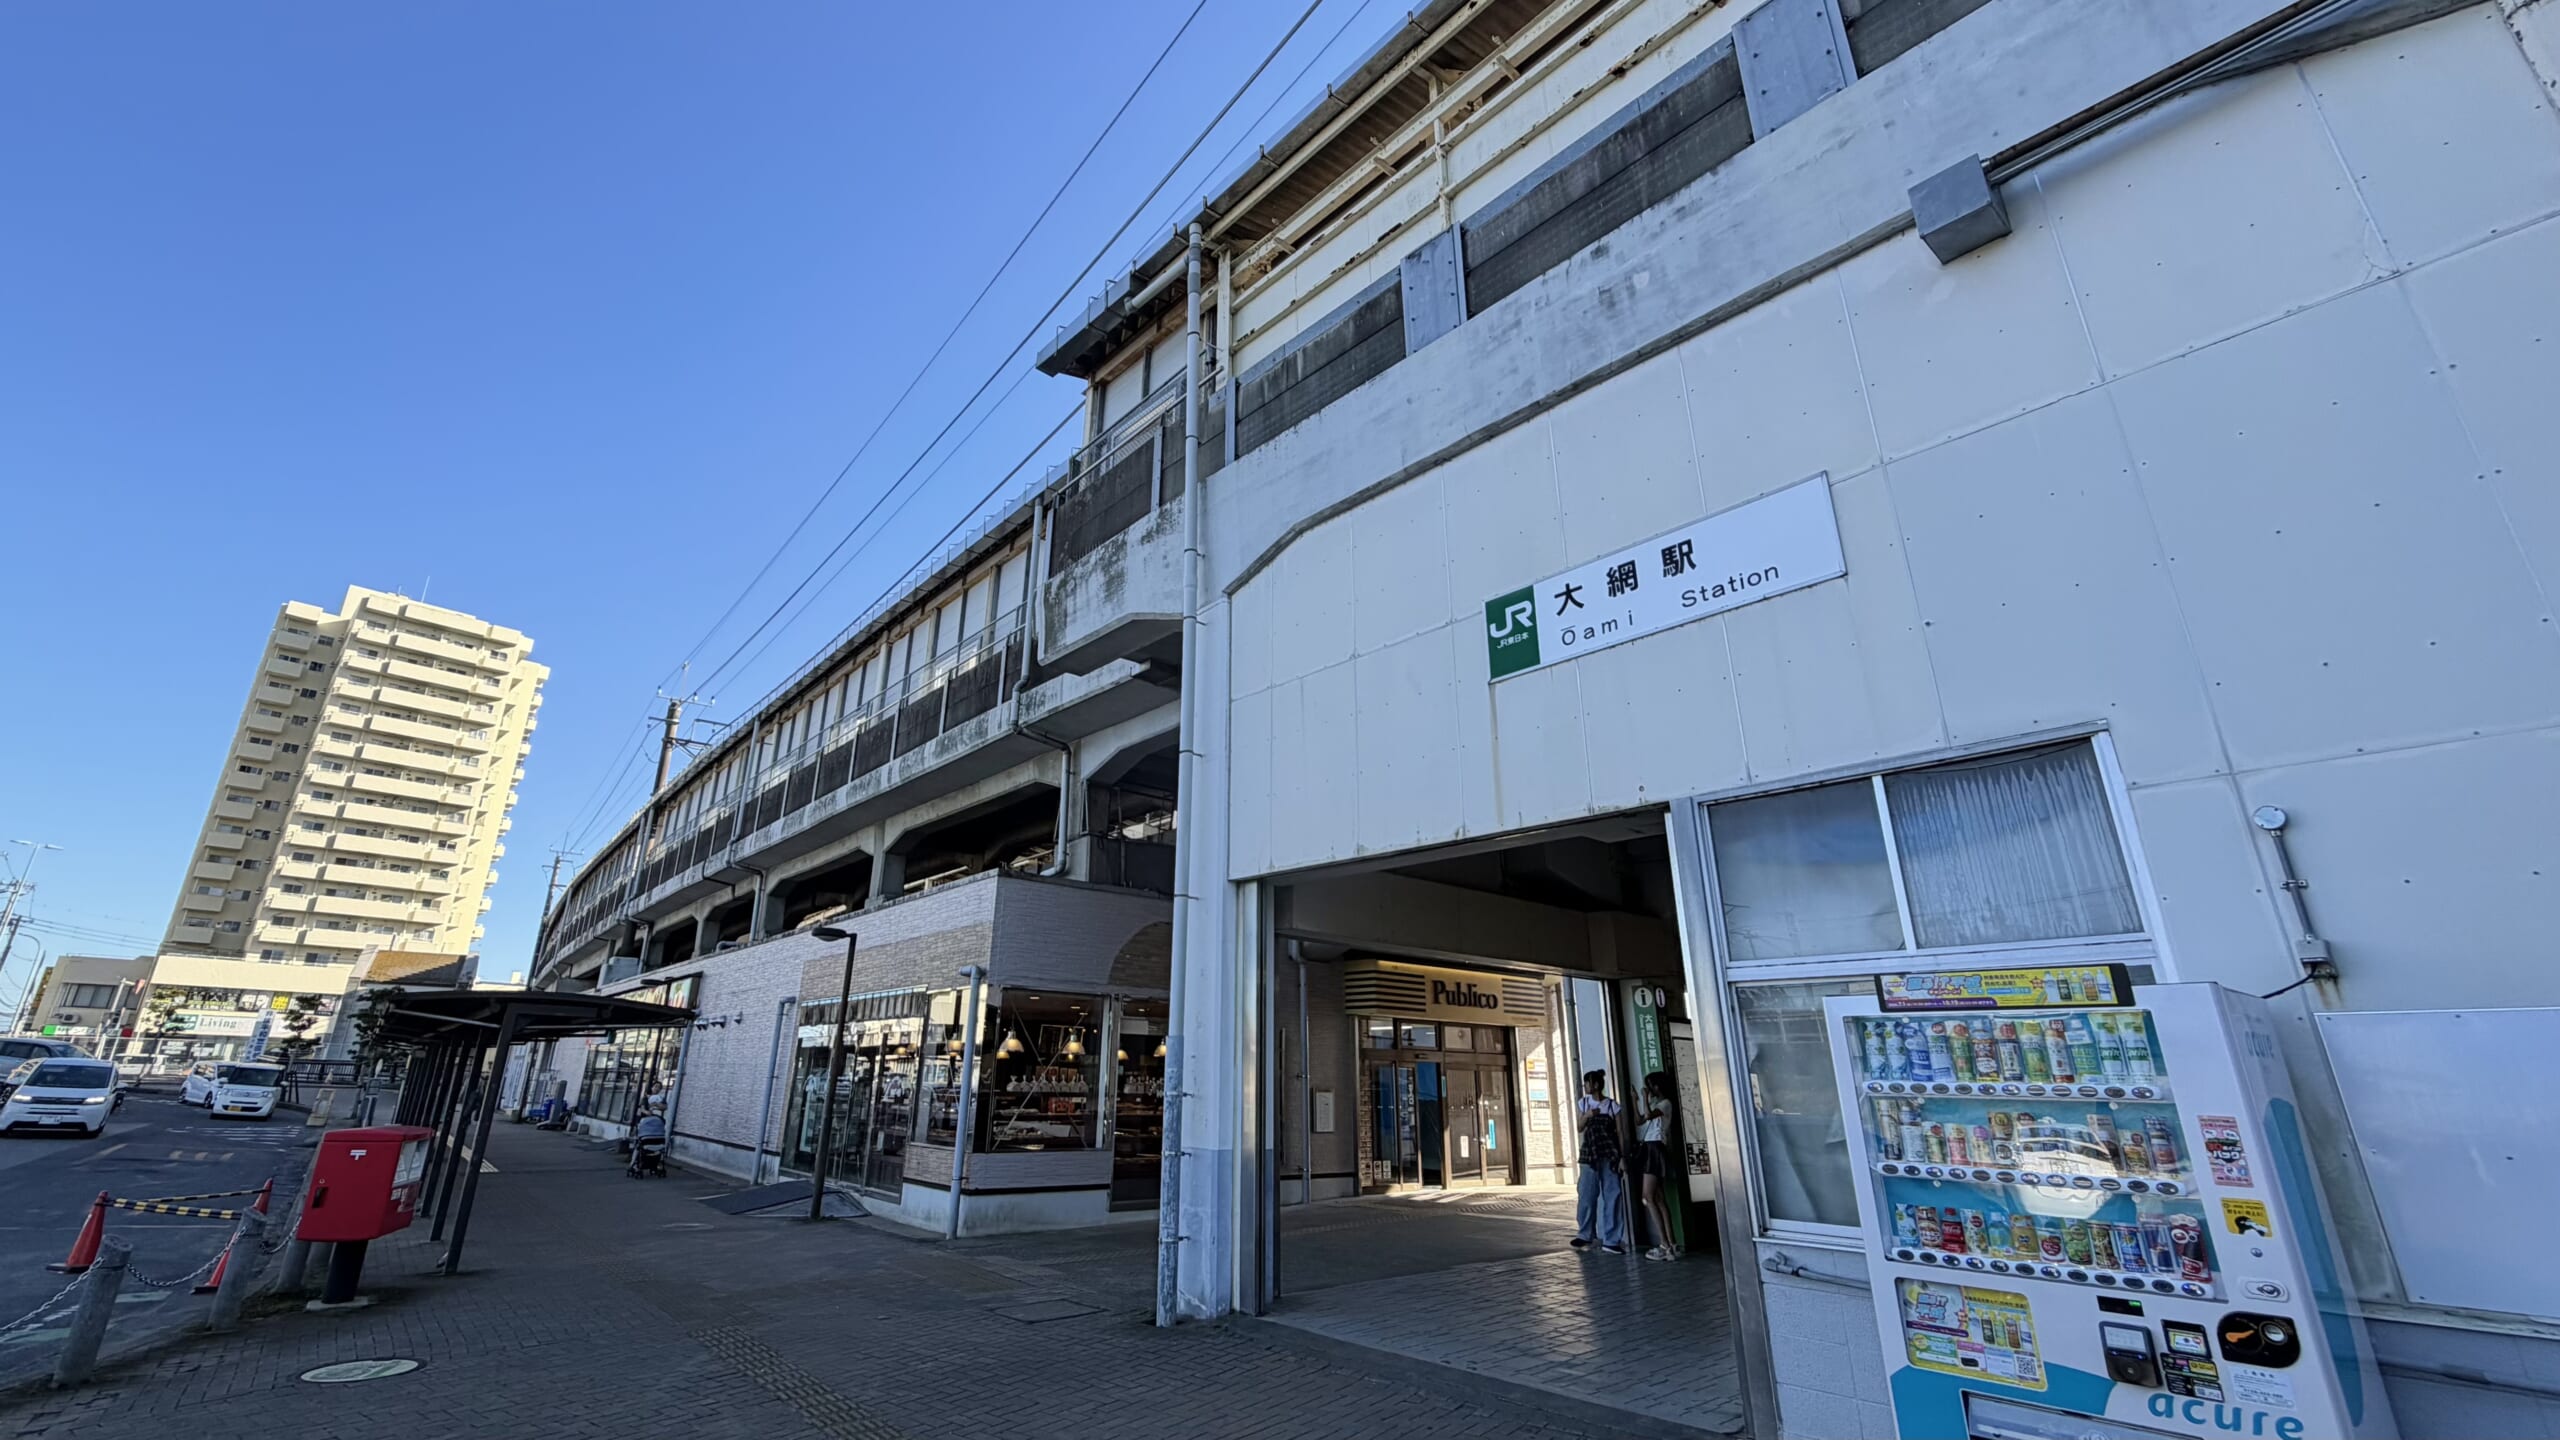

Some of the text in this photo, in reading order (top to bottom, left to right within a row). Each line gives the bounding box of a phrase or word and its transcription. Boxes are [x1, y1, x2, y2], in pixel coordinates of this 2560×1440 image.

[1554, 539, 1697, 617] 大網駅
[1489, 600, 1534, 638] JR
[1561, 566, 1779, 646] Ōami Station
[1496, 632, 1529, 649] JR東日本
[1431, 979, 1498, 1010] Publico
[2147, 1393, 2304, 1440] acure
